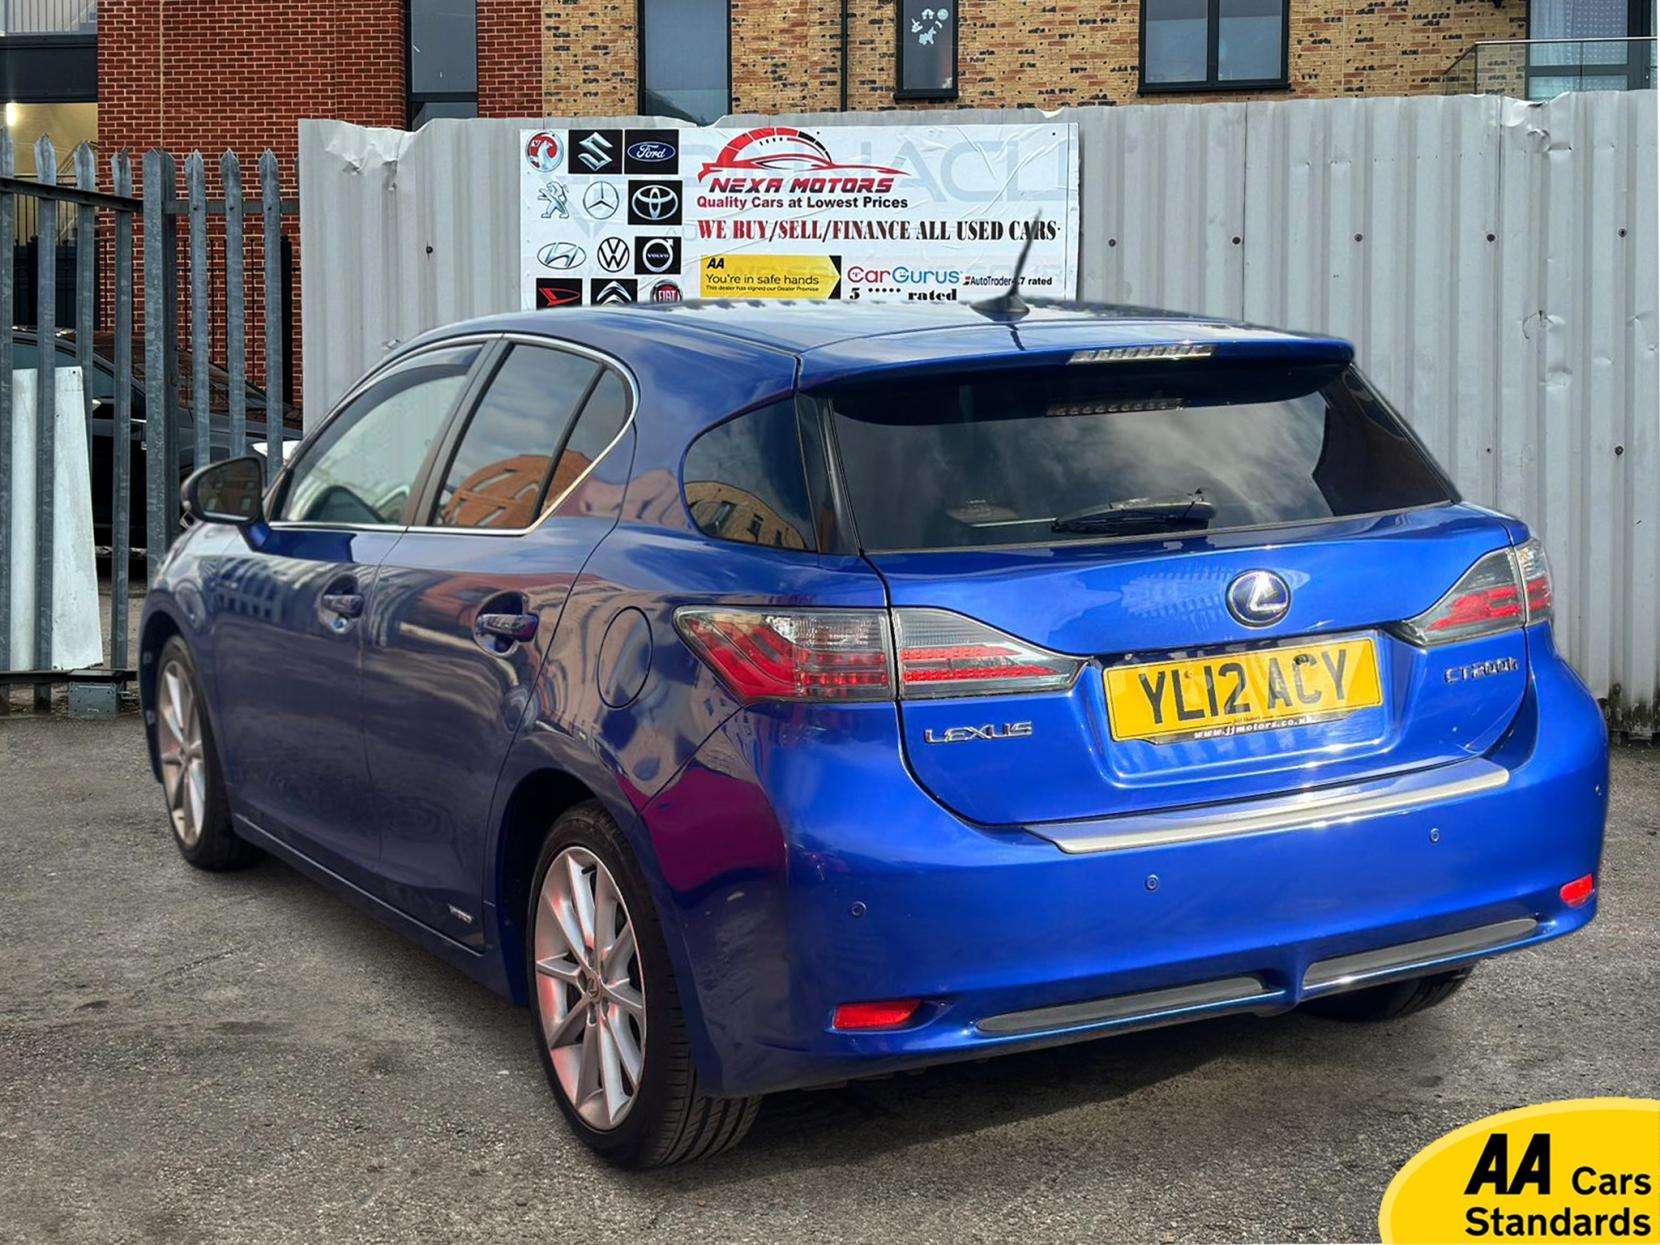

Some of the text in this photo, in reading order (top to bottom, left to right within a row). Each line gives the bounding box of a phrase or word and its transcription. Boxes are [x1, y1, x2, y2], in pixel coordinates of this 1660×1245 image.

[636, 144, 666, 158] Ford
[709, 178, 894, 193] NEXA MOTORS
[697, 196, 908, 208] Quality Cars at Lowest Prices
[697, 220, 726, 239] WE
[733, 219, 910, 243] BUY/SELL/FINANCE
[916, 220, 950, 240] ALL
[956, 220, 1004, 240] USED
[707, 258, 725, 269] AA
[706, 273, 819, 285] You're in safe hands
[847, 266, 960, 284] CarGurus
[970, 276, 1012, 286] AutoTrader
[1028, 277, 1053, 285] rated
[849, 288, 957, 301] 5 rated
[1138, 649, 1347, 724] YL12 ACY
[924, 720, 1033, 744] LEXUS
